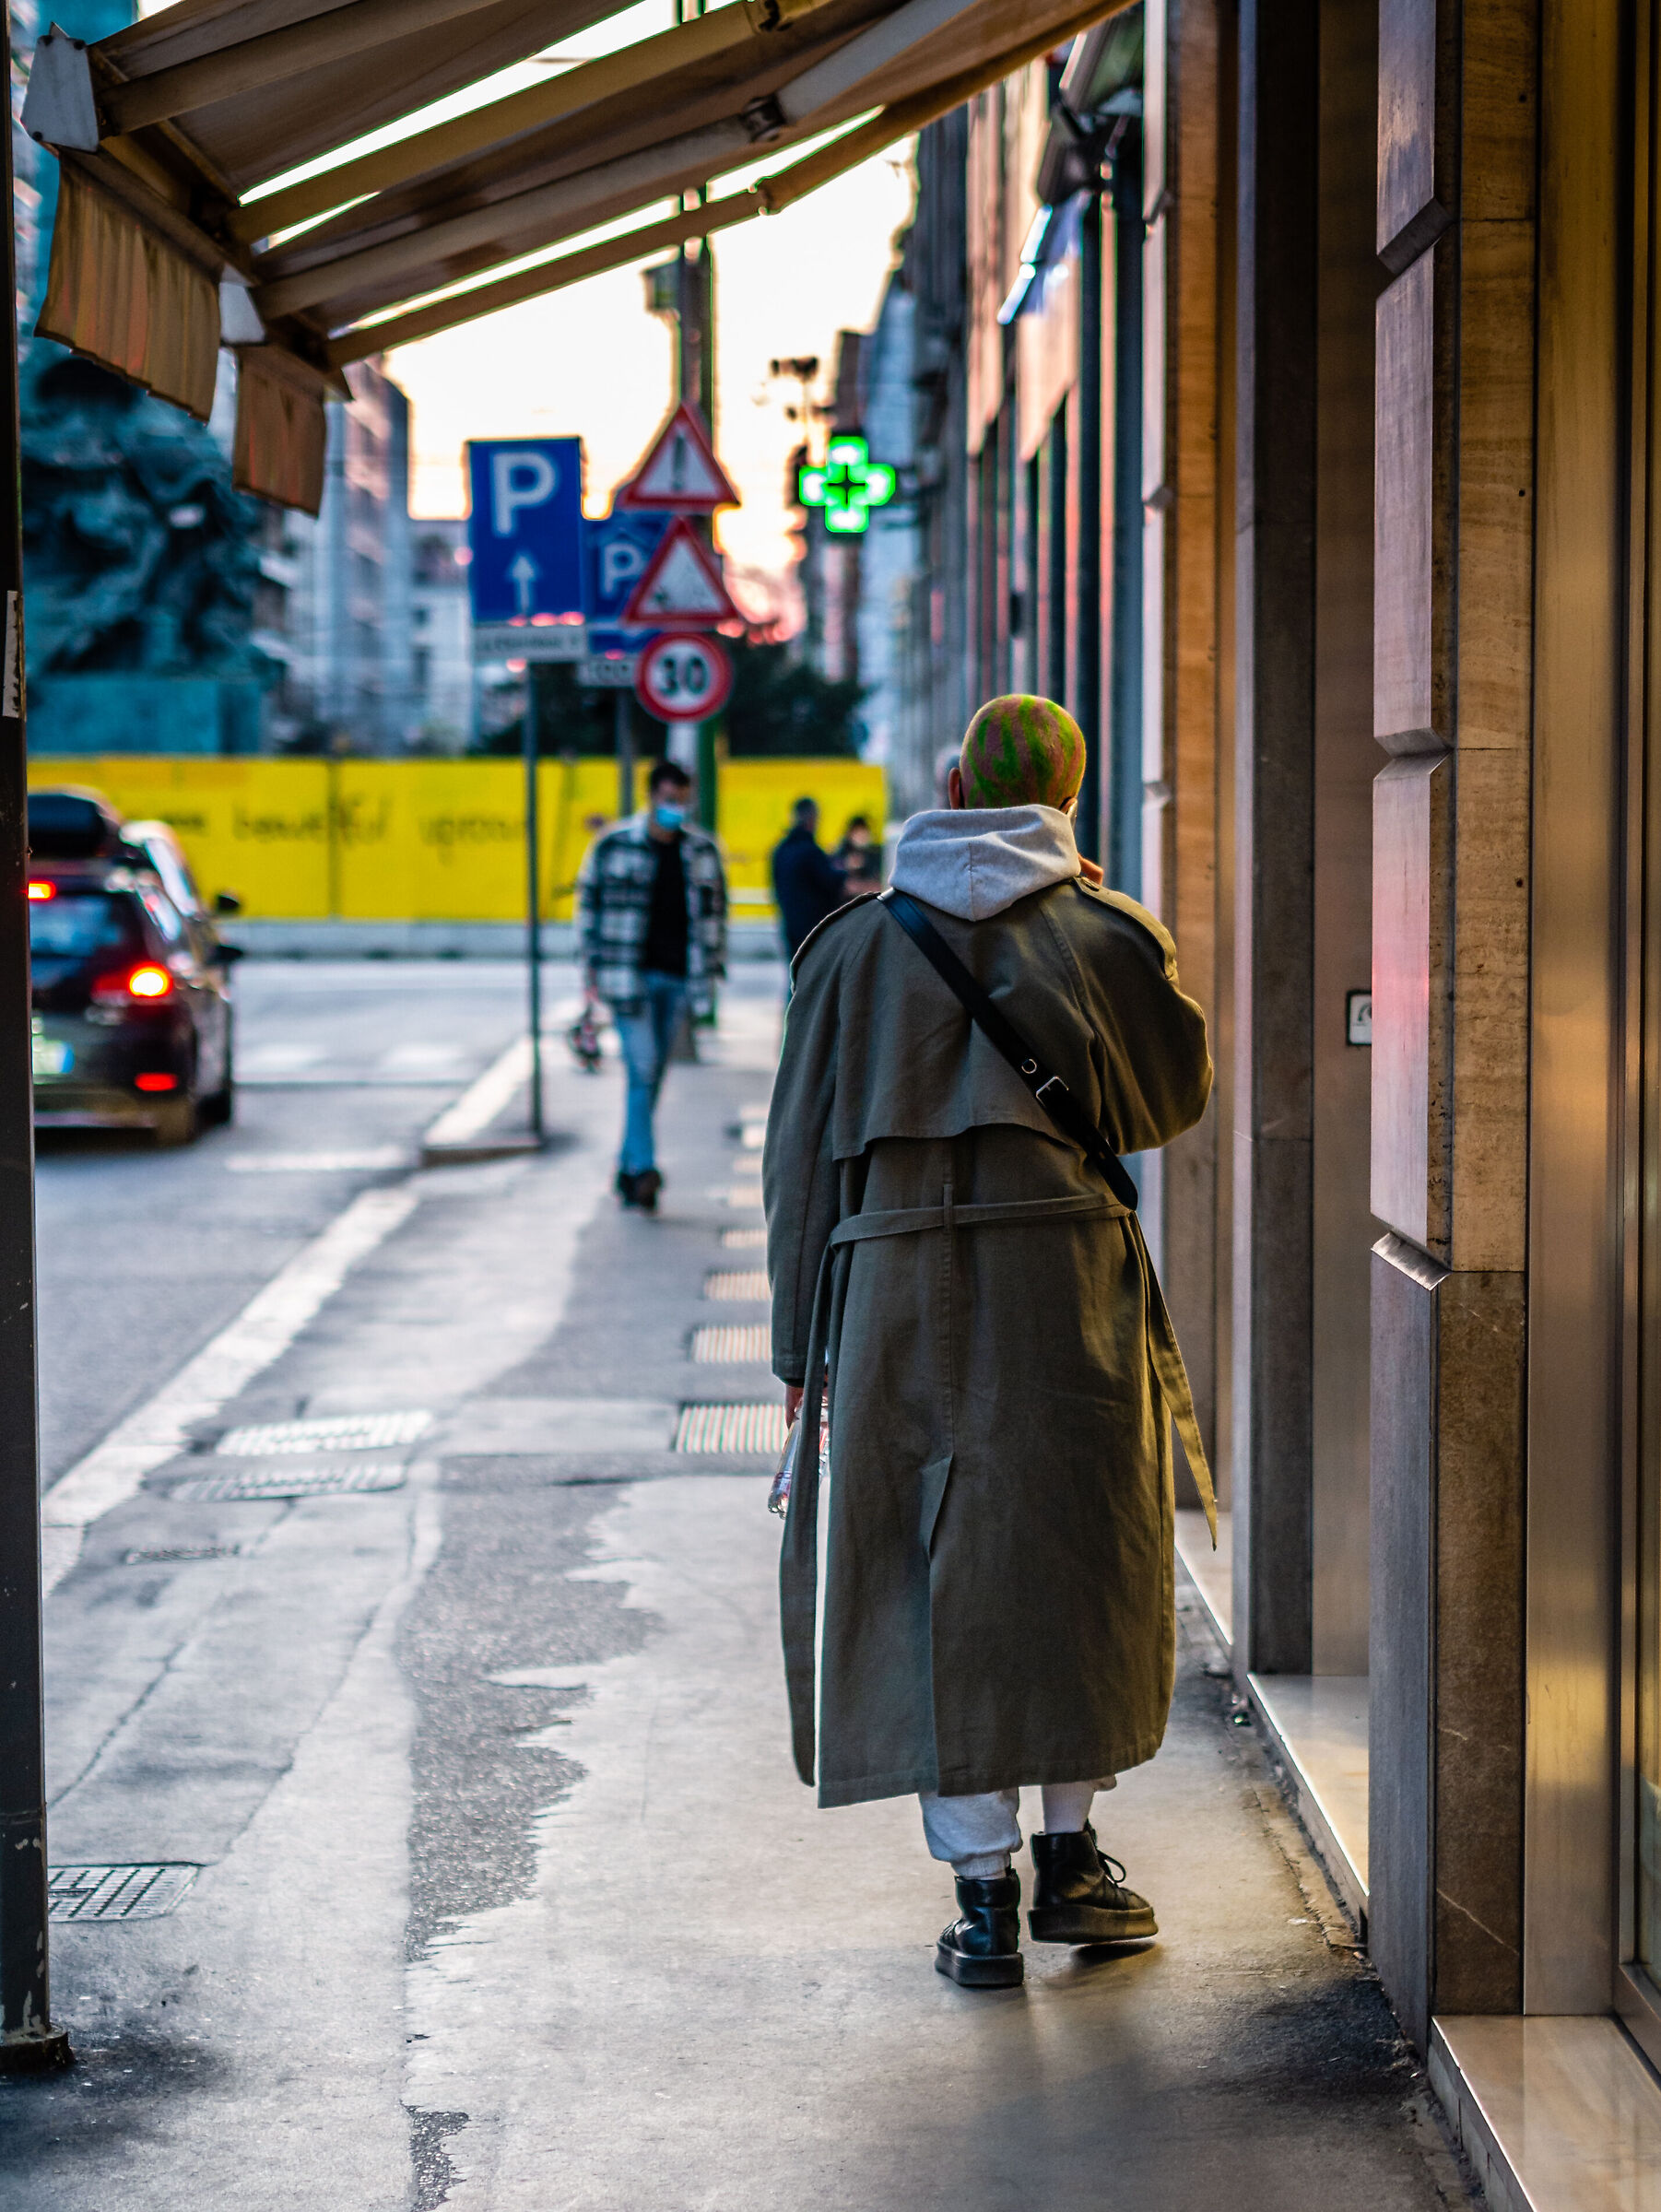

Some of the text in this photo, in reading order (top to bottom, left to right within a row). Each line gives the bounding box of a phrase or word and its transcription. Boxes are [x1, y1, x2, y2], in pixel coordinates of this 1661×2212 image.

[493, 452, 557, 536] P
[602, 542, 644, 595] P
[659, 656, 707, 696] 30
